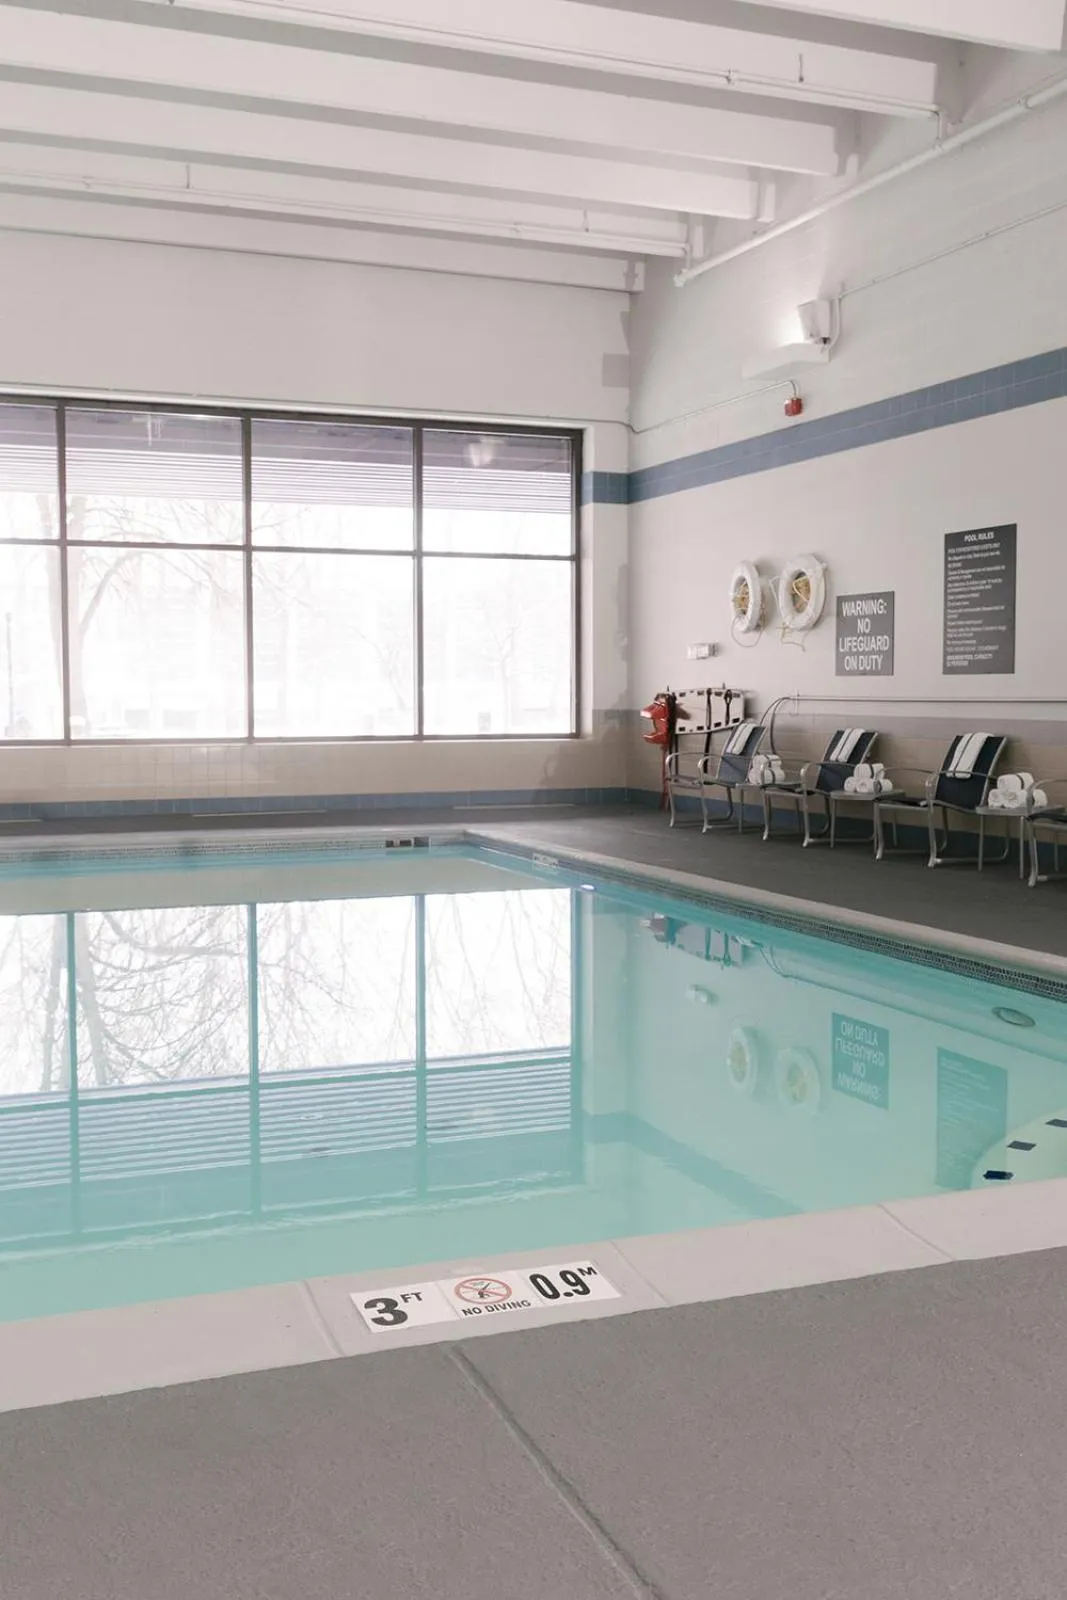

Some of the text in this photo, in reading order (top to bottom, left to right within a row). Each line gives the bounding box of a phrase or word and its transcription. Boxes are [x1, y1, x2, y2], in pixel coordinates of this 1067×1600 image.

[964, 531, 994, 542] POOL RULES
[842, 599, 887, 617] WARNING:
[857, 618, 871, 634] NO
[839, 635, 890, 652] LIFEGUARD
[844, 654, 883, 671] ON DUTY
[528, 1266, 598, 1299] 0.9 M
[364, 1291, 423, 1326] 3 FT
[462, 1299, 532, 1317] NO DIVING
